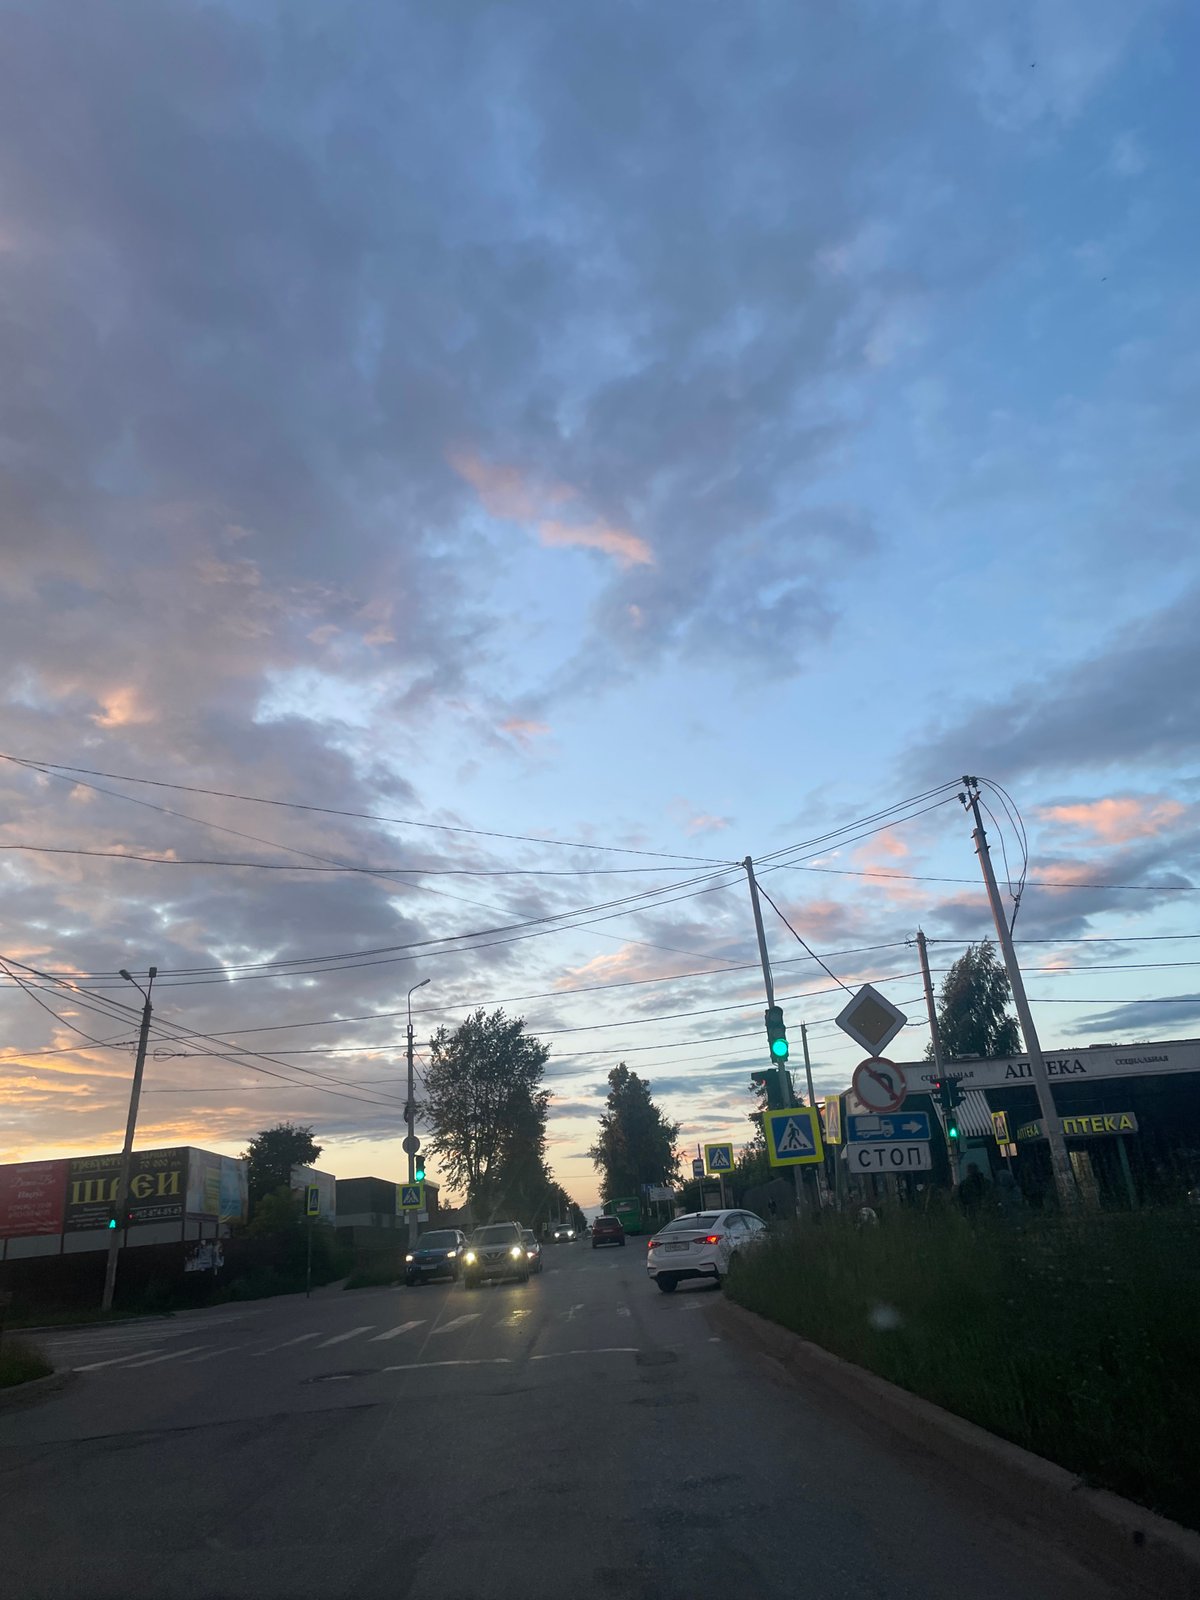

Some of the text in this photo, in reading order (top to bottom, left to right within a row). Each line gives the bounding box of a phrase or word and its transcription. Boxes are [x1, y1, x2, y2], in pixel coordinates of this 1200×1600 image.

[1005, 1059, 1086, 1079] АПЕКА
[1062, 1114, 1133, 1135] ПТЕКА
[858, 1147, 922, 1168] СТОП
